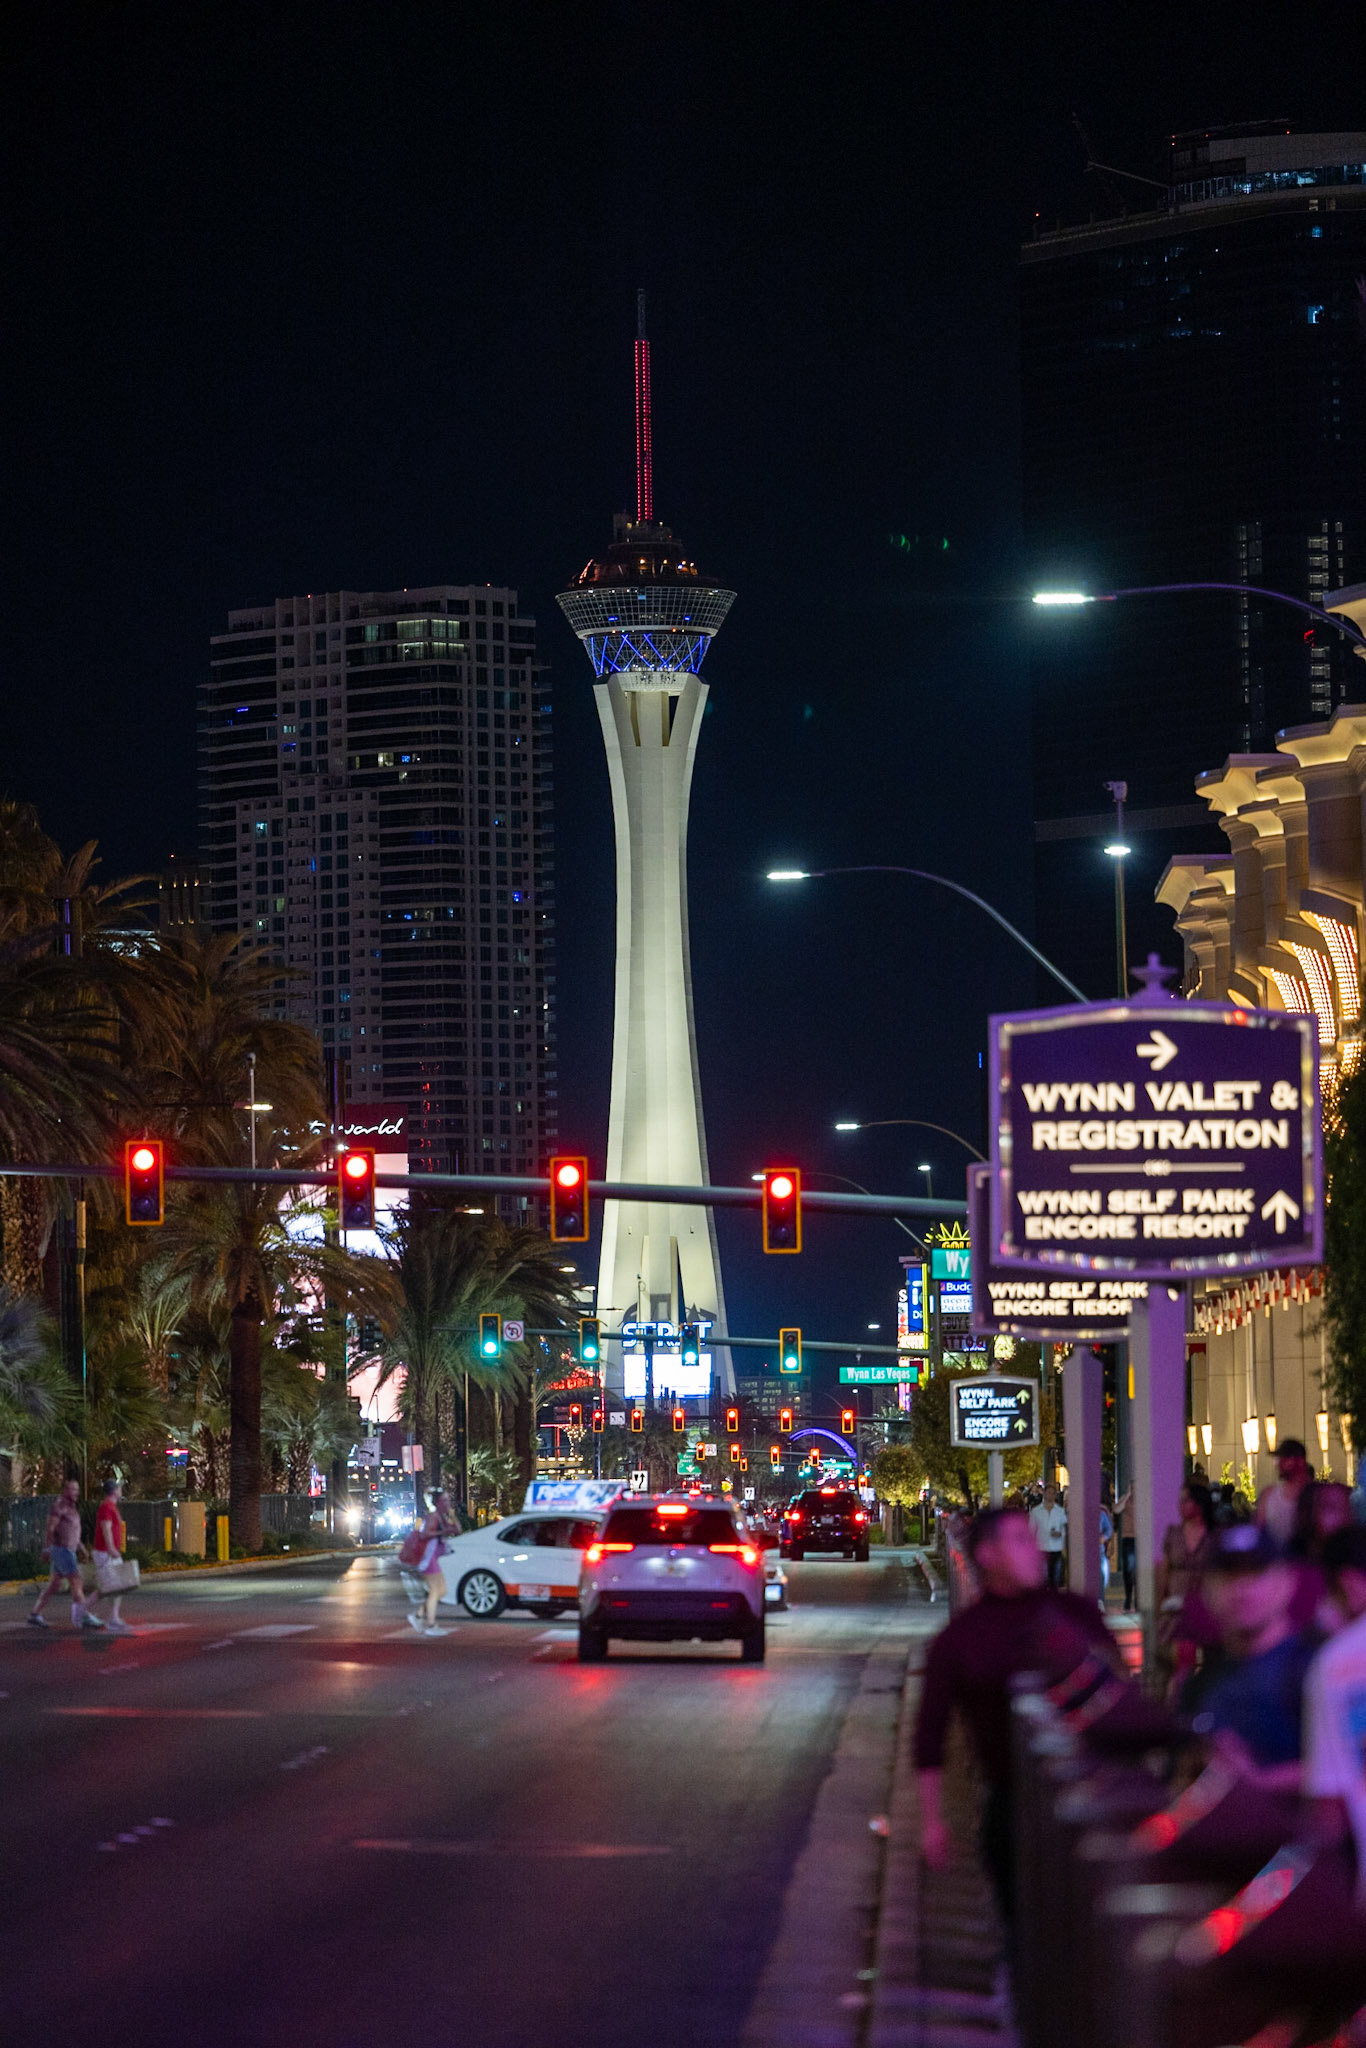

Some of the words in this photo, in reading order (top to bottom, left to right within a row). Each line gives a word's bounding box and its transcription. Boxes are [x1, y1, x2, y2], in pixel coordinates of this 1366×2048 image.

[1021, 1082, 1135, 1112] WYNN
[1145, 1081, 1260, 1111] VALET
[1270, 1080, 1298, 1111] &
[1032, 1119, 1288, 1151] REGISTRATION
[1017, 1191, 1101, 1215] WYNN
[1107, 1190, 1177, 1214] SELF
[1182, 1189, 1255, 1213] PARK
[1025, 1215, 1136, 1240] ENCORE
[1143, 1215, 1249, 1239] RESORT
[988, 1282, 1046, 1299] WYNN
[1048, 1282, 1096, 1299] SELF
[1099, 1281, 1148, 1299] PARK
[993, 1299, 1069, 1316] ENCORE
[622, 1321, 713, 1347] STRT
[846, 1367, 869, 1383] Wynn
[871, 1367, 885, 1380] Las
[886, 1367, 911, 1383] Vegas
[959, 1388, 994, 1399] WYNN
[959, 1398, 987, 1409] SELF
[988, 1397, 1017, 1409] PARK
[964, 1416, 1010, 1428] ENCORE
[964, 1427, 1009, 1439] RESORT
